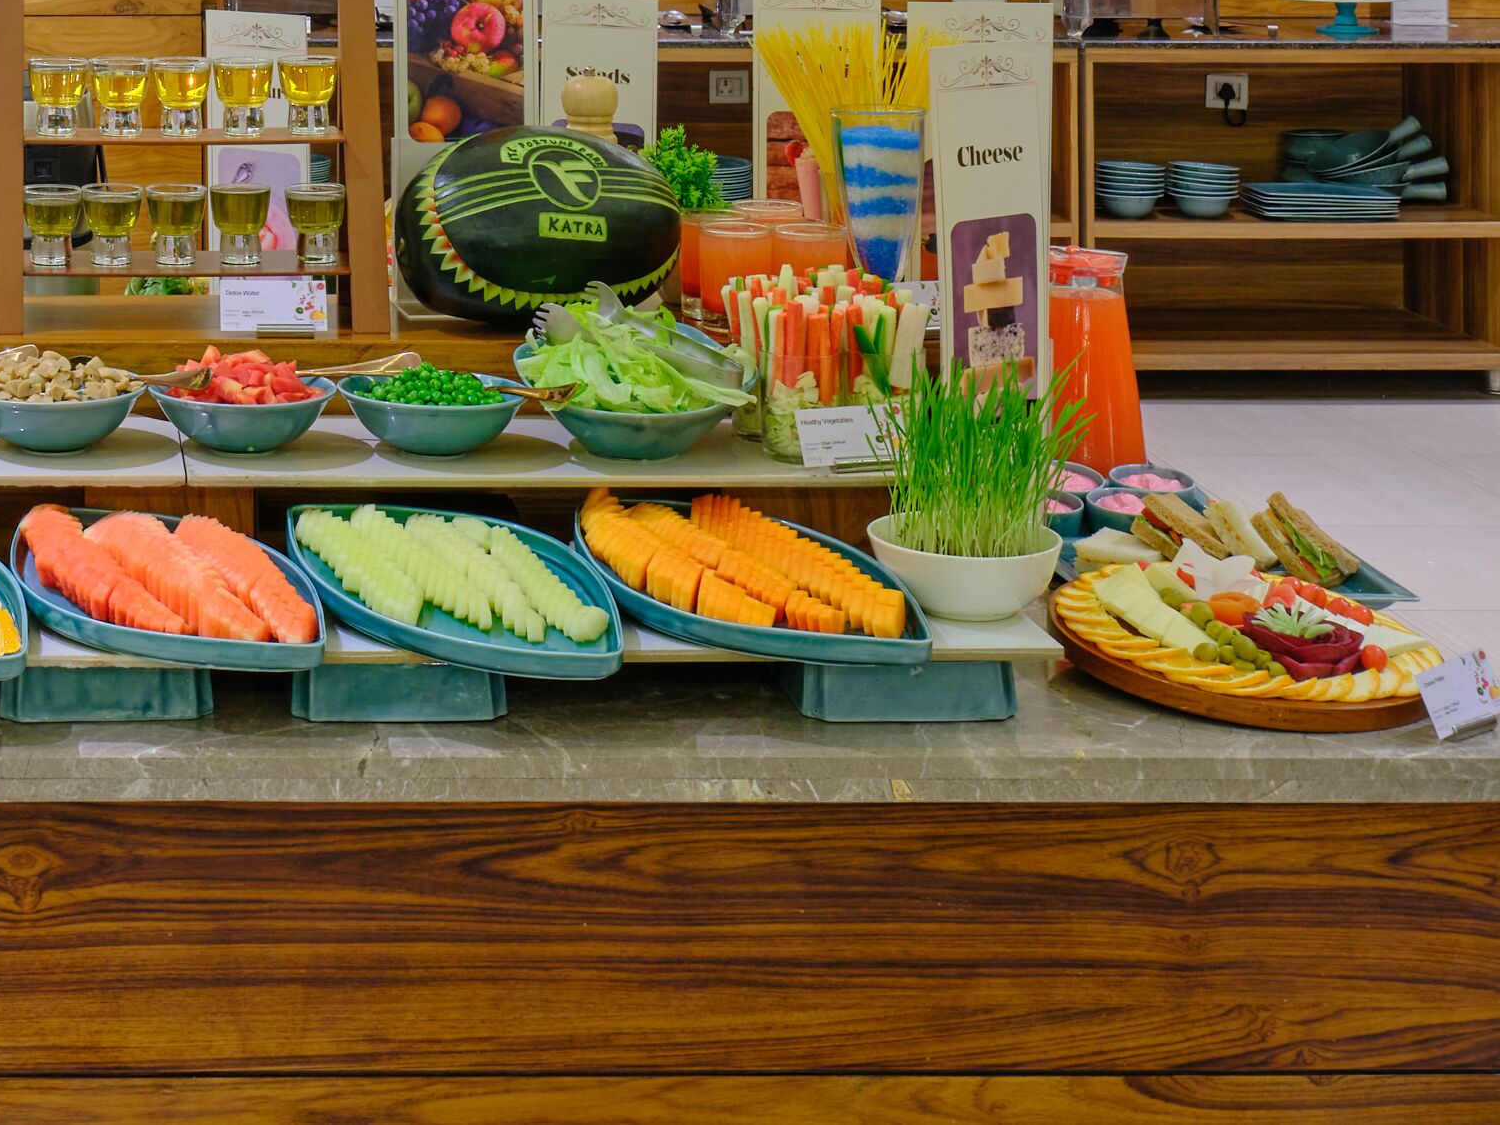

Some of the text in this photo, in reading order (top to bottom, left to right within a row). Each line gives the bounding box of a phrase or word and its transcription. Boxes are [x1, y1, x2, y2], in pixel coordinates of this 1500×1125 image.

[517, 138, 574, 149] FORTUNE
[957, 145, 1024, 167] Cheese
[548, 216, 603, 236] KATRA
[800, 417, 854, 426] Healthy Vegetables
